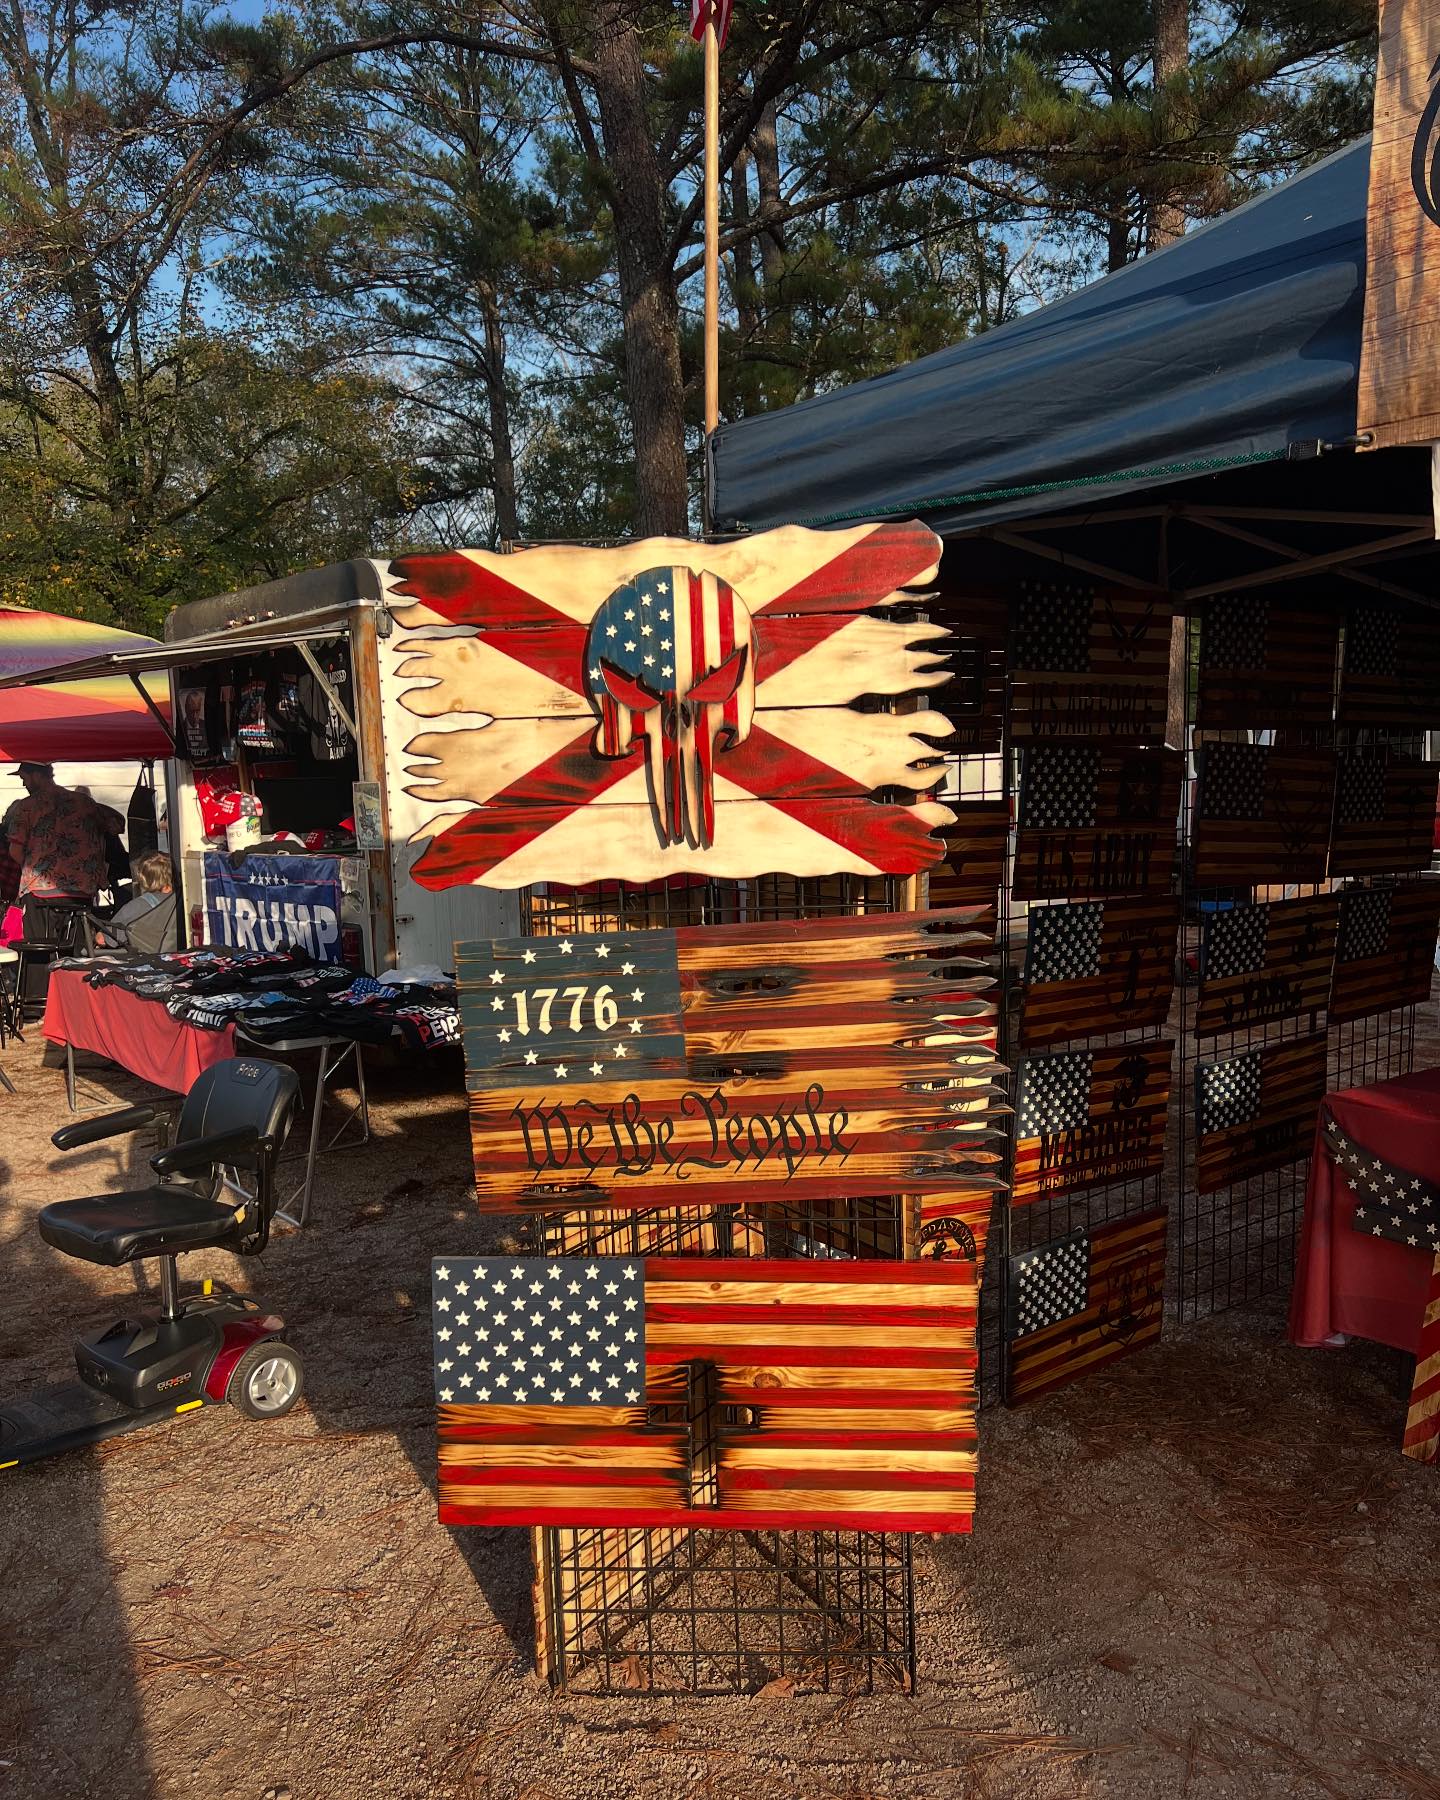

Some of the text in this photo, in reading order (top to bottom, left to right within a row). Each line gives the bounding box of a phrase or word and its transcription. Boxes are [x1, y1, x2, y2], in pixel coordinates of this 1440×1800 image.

[215, 896, 339, 962] TRUMP
[512, 984, 620, 1036] 1776
[509, 1082, 860, 1186] We the People
[1039, 1112, 1153, 1170] MARINES
